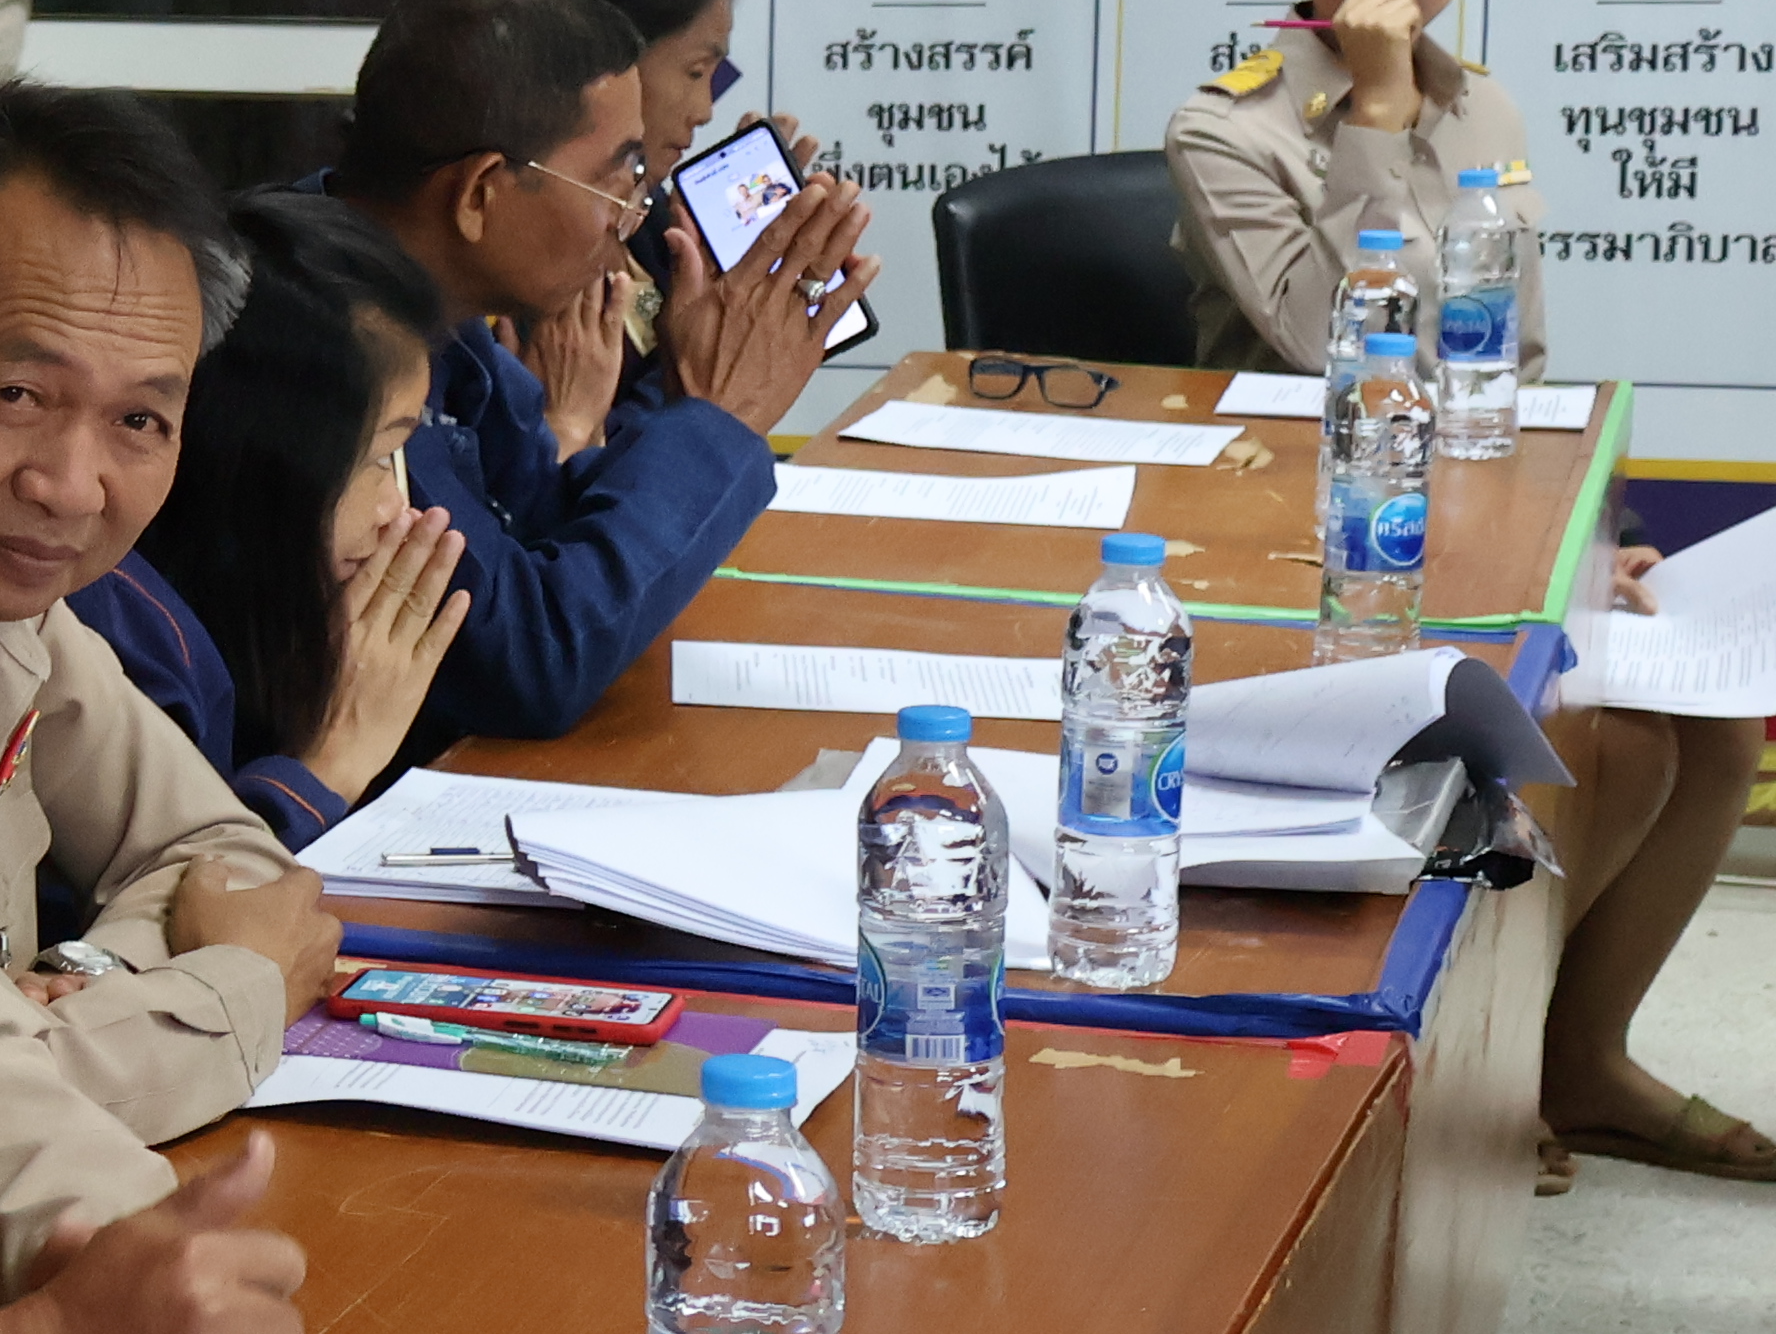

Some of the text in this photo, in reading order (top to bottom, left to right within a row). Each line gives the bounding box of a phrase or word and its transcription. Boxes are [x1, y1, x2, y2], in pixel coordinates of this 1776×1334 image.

[824, 28, 1036, 72] สร้างสรรค์
[1554, 27, 1775, 72] เสริมสร้าง
[866, 99, 988, 147] ชุมชน
[1561, 105, 1761, 154] ทุนชุมชน
[1611, 148, 1699, 199] ให้มี
